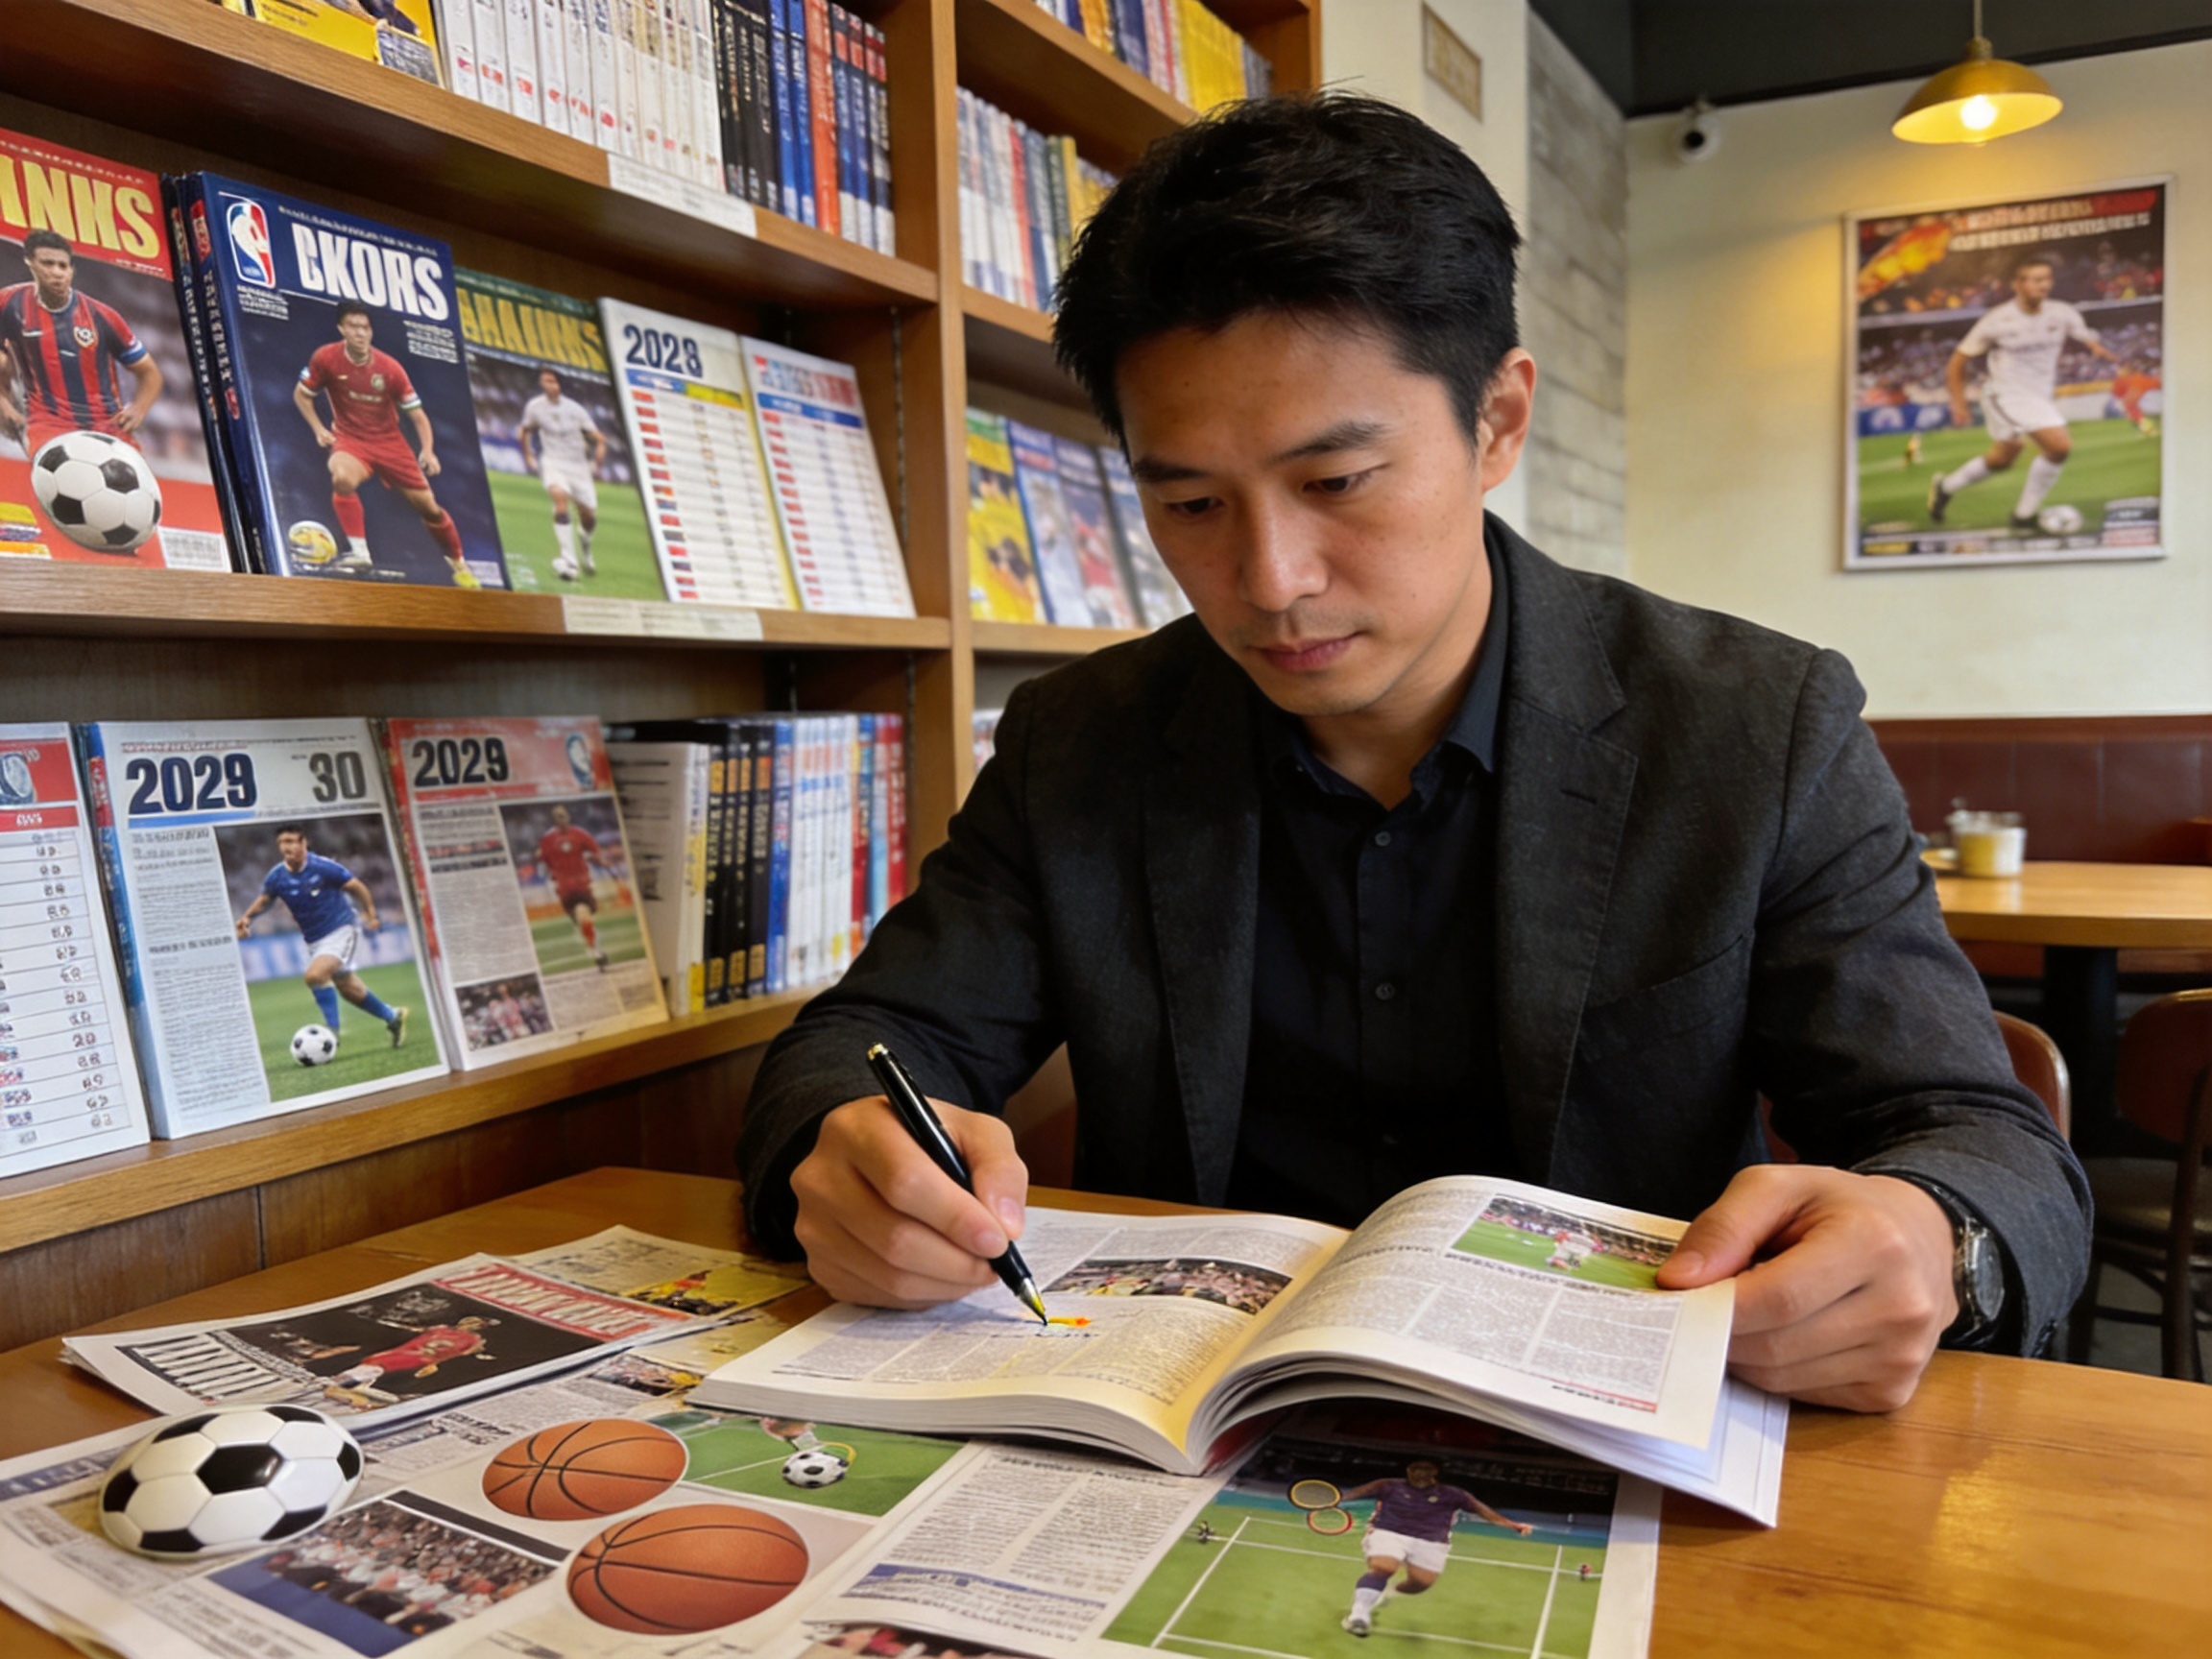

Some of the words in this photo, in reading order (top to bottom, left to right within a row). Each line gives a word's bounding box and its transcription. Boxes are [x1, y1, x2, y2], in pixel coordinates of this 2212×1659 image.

[126, 753, 257, 815] 2029
[309, 751, 366, 803] 30
[413, 737, 509, 787] 2029
